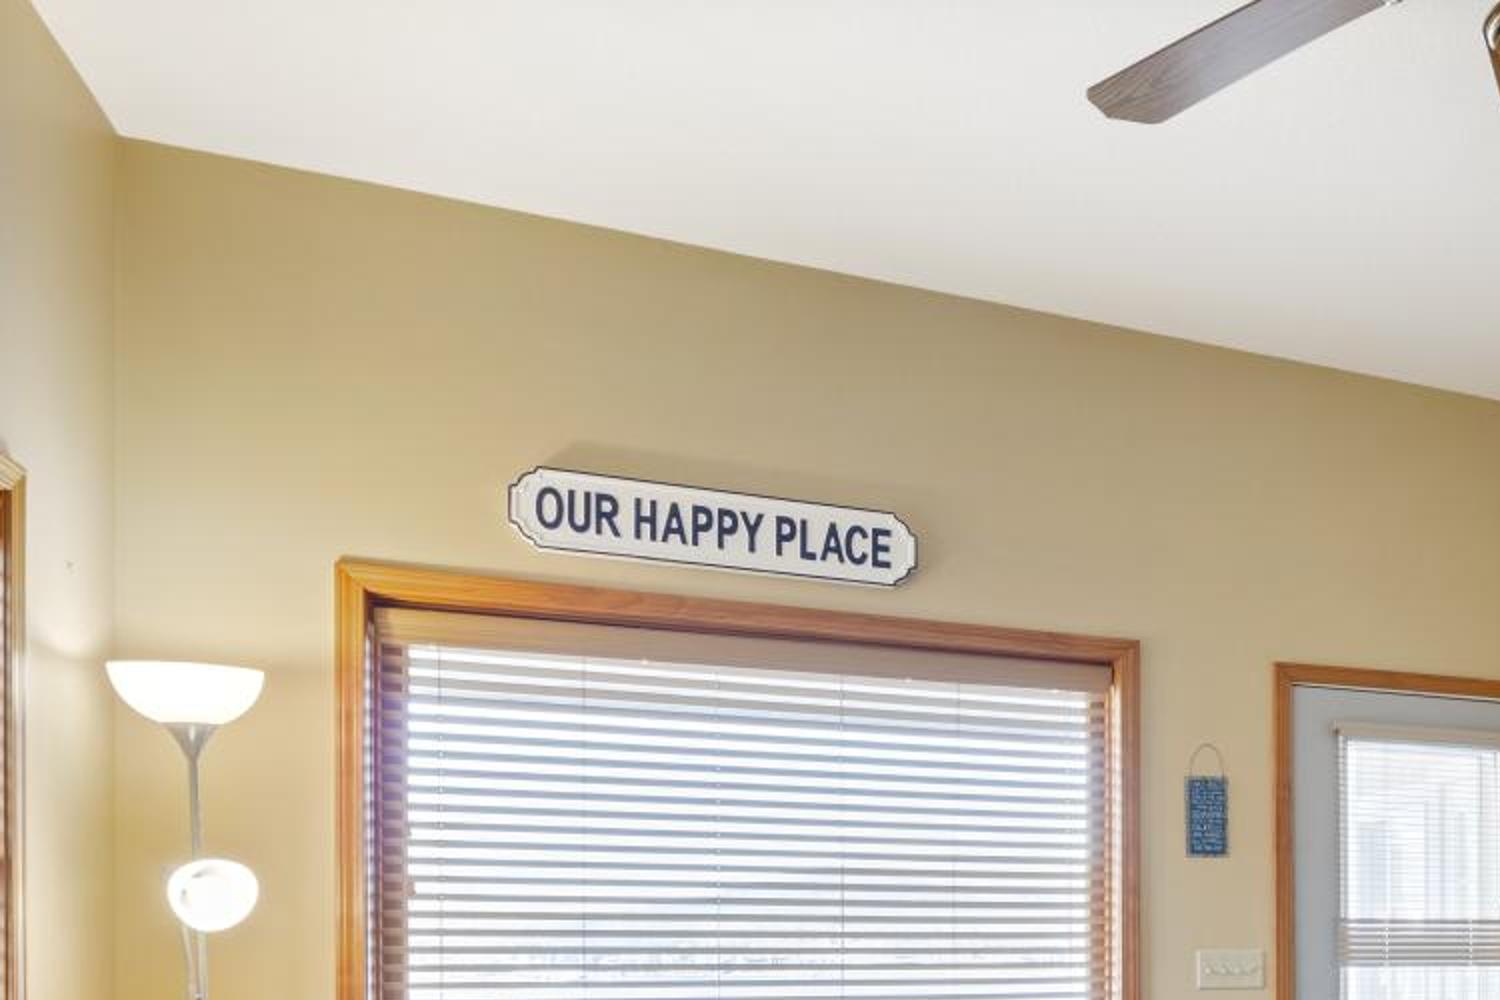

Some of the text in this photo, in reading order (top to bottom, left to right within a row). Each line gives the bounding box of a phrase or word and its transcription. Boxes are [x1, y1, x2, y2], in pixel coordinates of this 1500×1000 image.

[535, 486, 892, 568] OUR HAPPY PLACE
